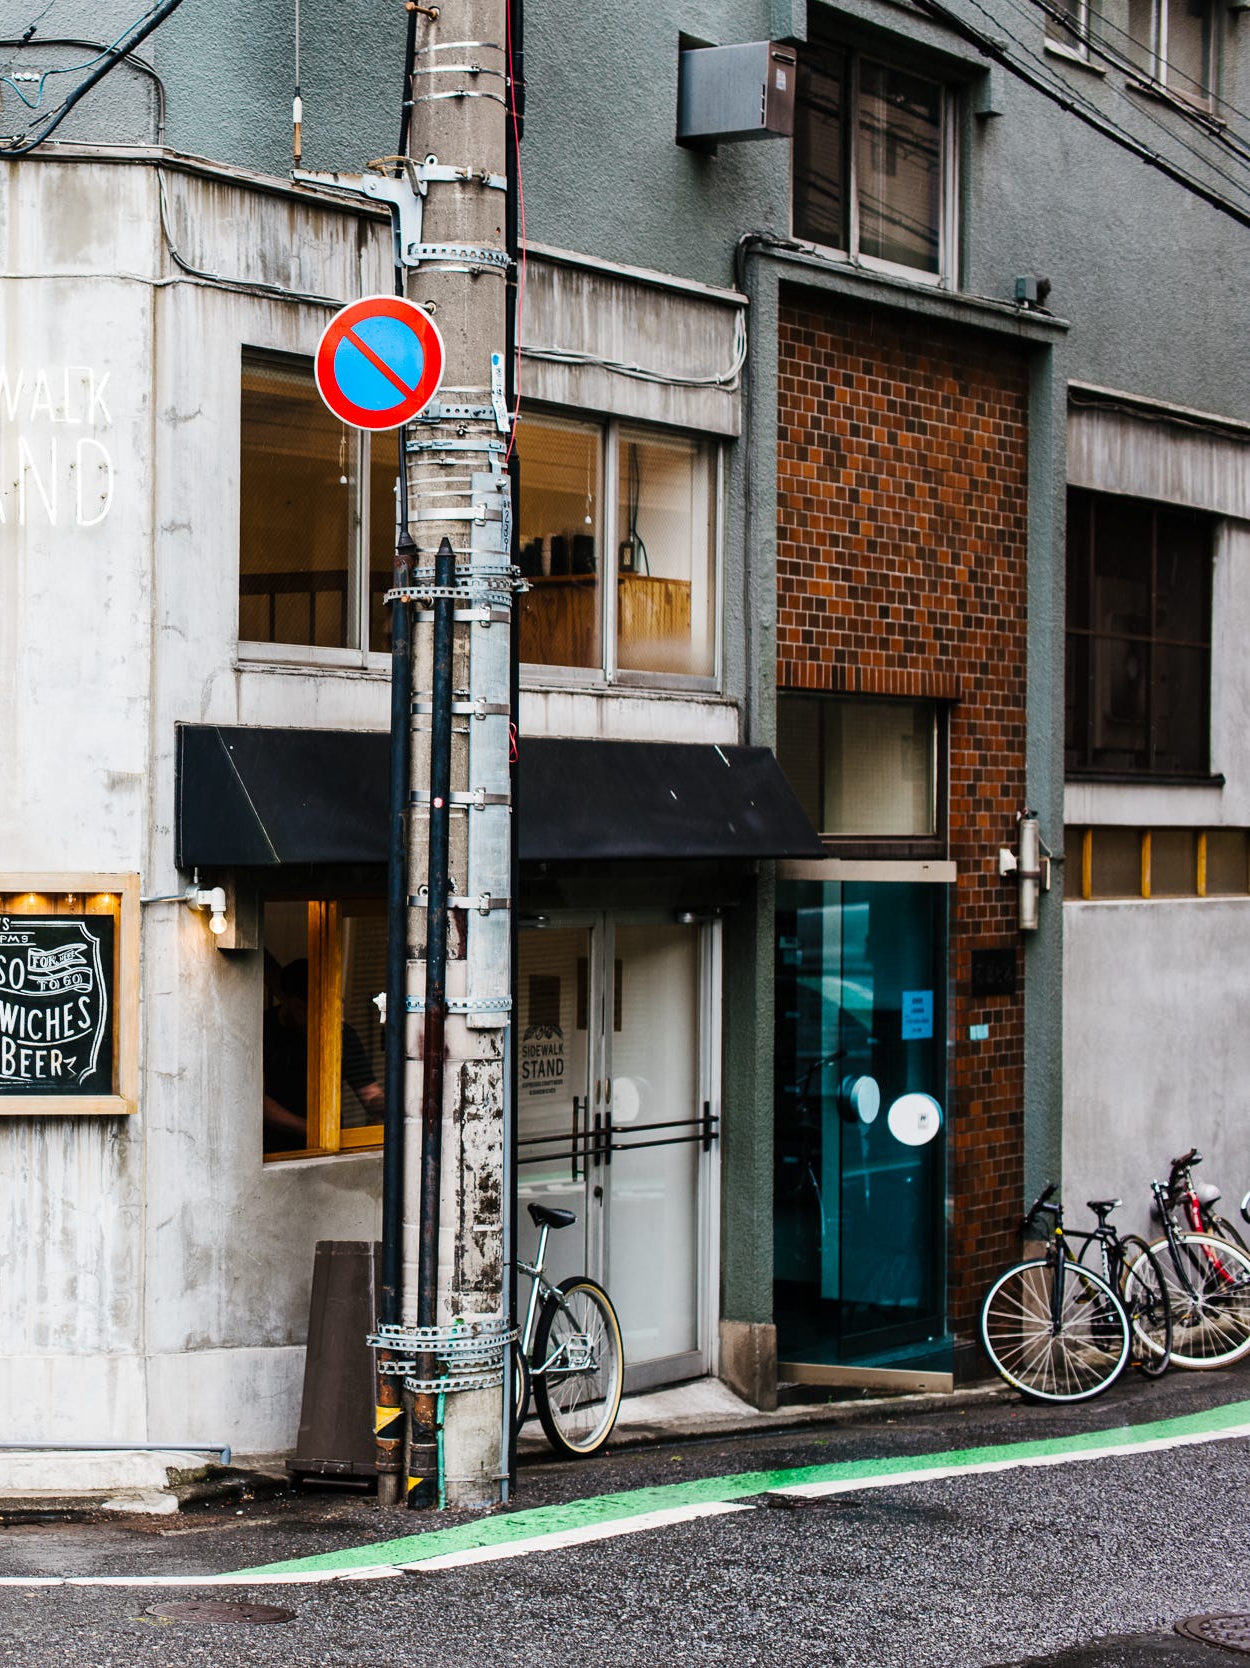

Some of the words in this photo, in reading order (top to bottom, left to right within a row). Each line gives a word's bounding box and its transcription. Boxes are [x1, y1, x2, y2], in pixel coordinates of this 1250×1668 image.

[36, 978, 60, 992] TO
[62, 973, 83, 986] GO
[1, 1035, 63, 1078] BEER
[522, 1043, 565, 1058] SIDEWALK
[522, 1058, 565, 1080] STAND
